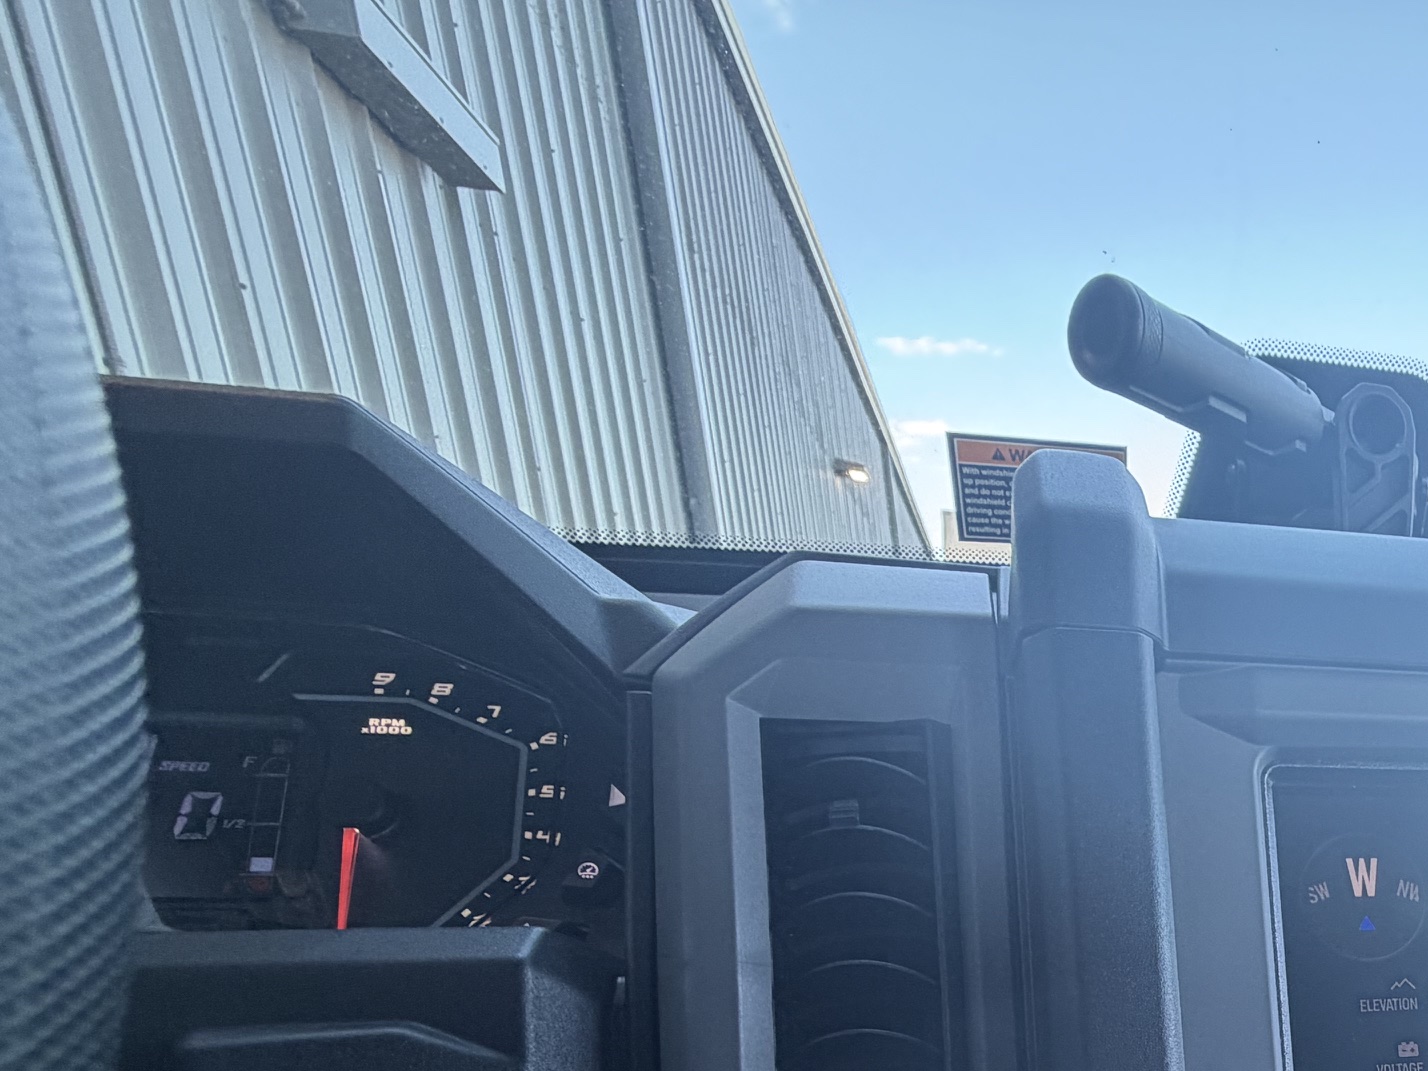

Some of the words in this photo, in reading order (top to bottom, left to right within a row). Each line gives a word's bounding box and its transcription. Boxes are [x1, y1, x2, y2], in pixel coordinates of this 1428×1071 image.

[962, 467, 979, 475] With
[372, 672, 396, 685] 9
[431, 682, 454, 695] 8
[487, 705, 501, 718] 7
[369, 718, 406, 727] RPM
[361, 726, 413, 735] x1000
[159, 761, 210, 772] SPEED
[1346, 858, 1378, 897] W
[1360, 998, 1418, 1012] ELEVATION
